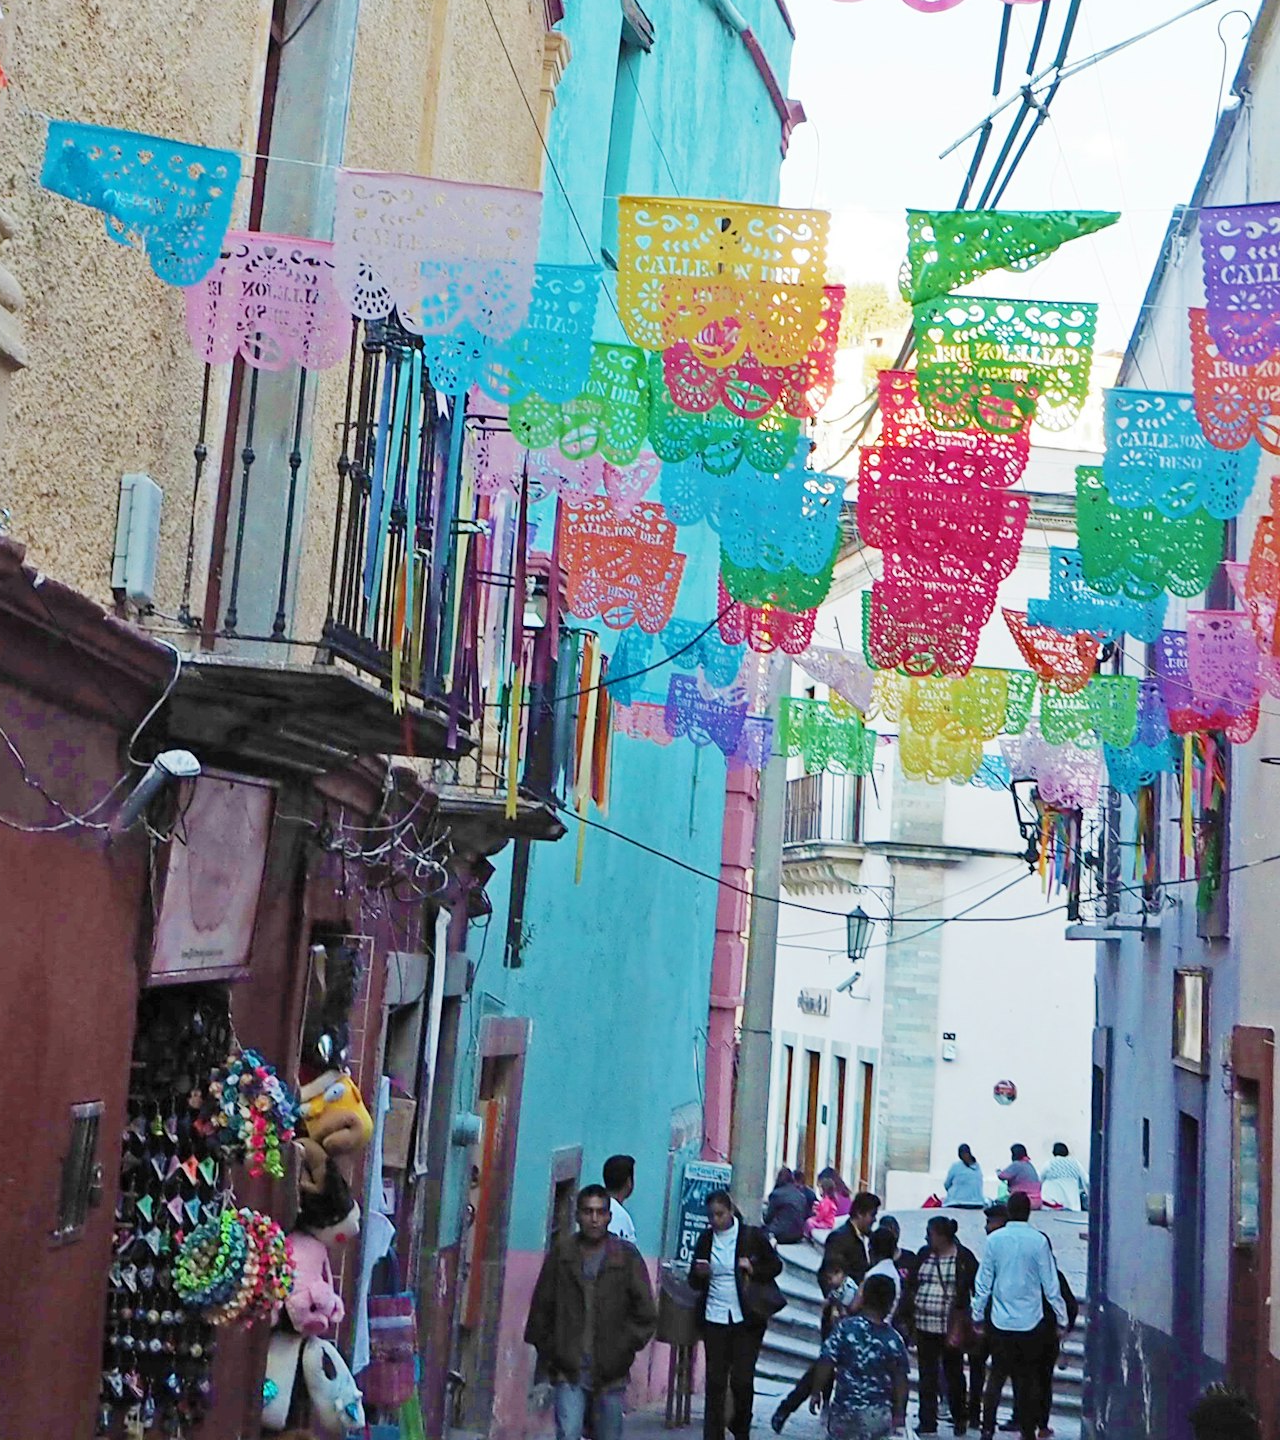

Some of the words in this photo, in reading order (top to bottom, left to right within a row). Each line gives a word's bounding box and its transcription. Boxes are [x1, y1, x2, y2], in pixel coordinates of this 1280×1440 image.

[1116, 431, 1206, 449] CALLEJON
[1158, 456, 1203, 470] BESO
[568, 522, 637, 538] CALLEJON
[639, 531, 664, 546] DEL
